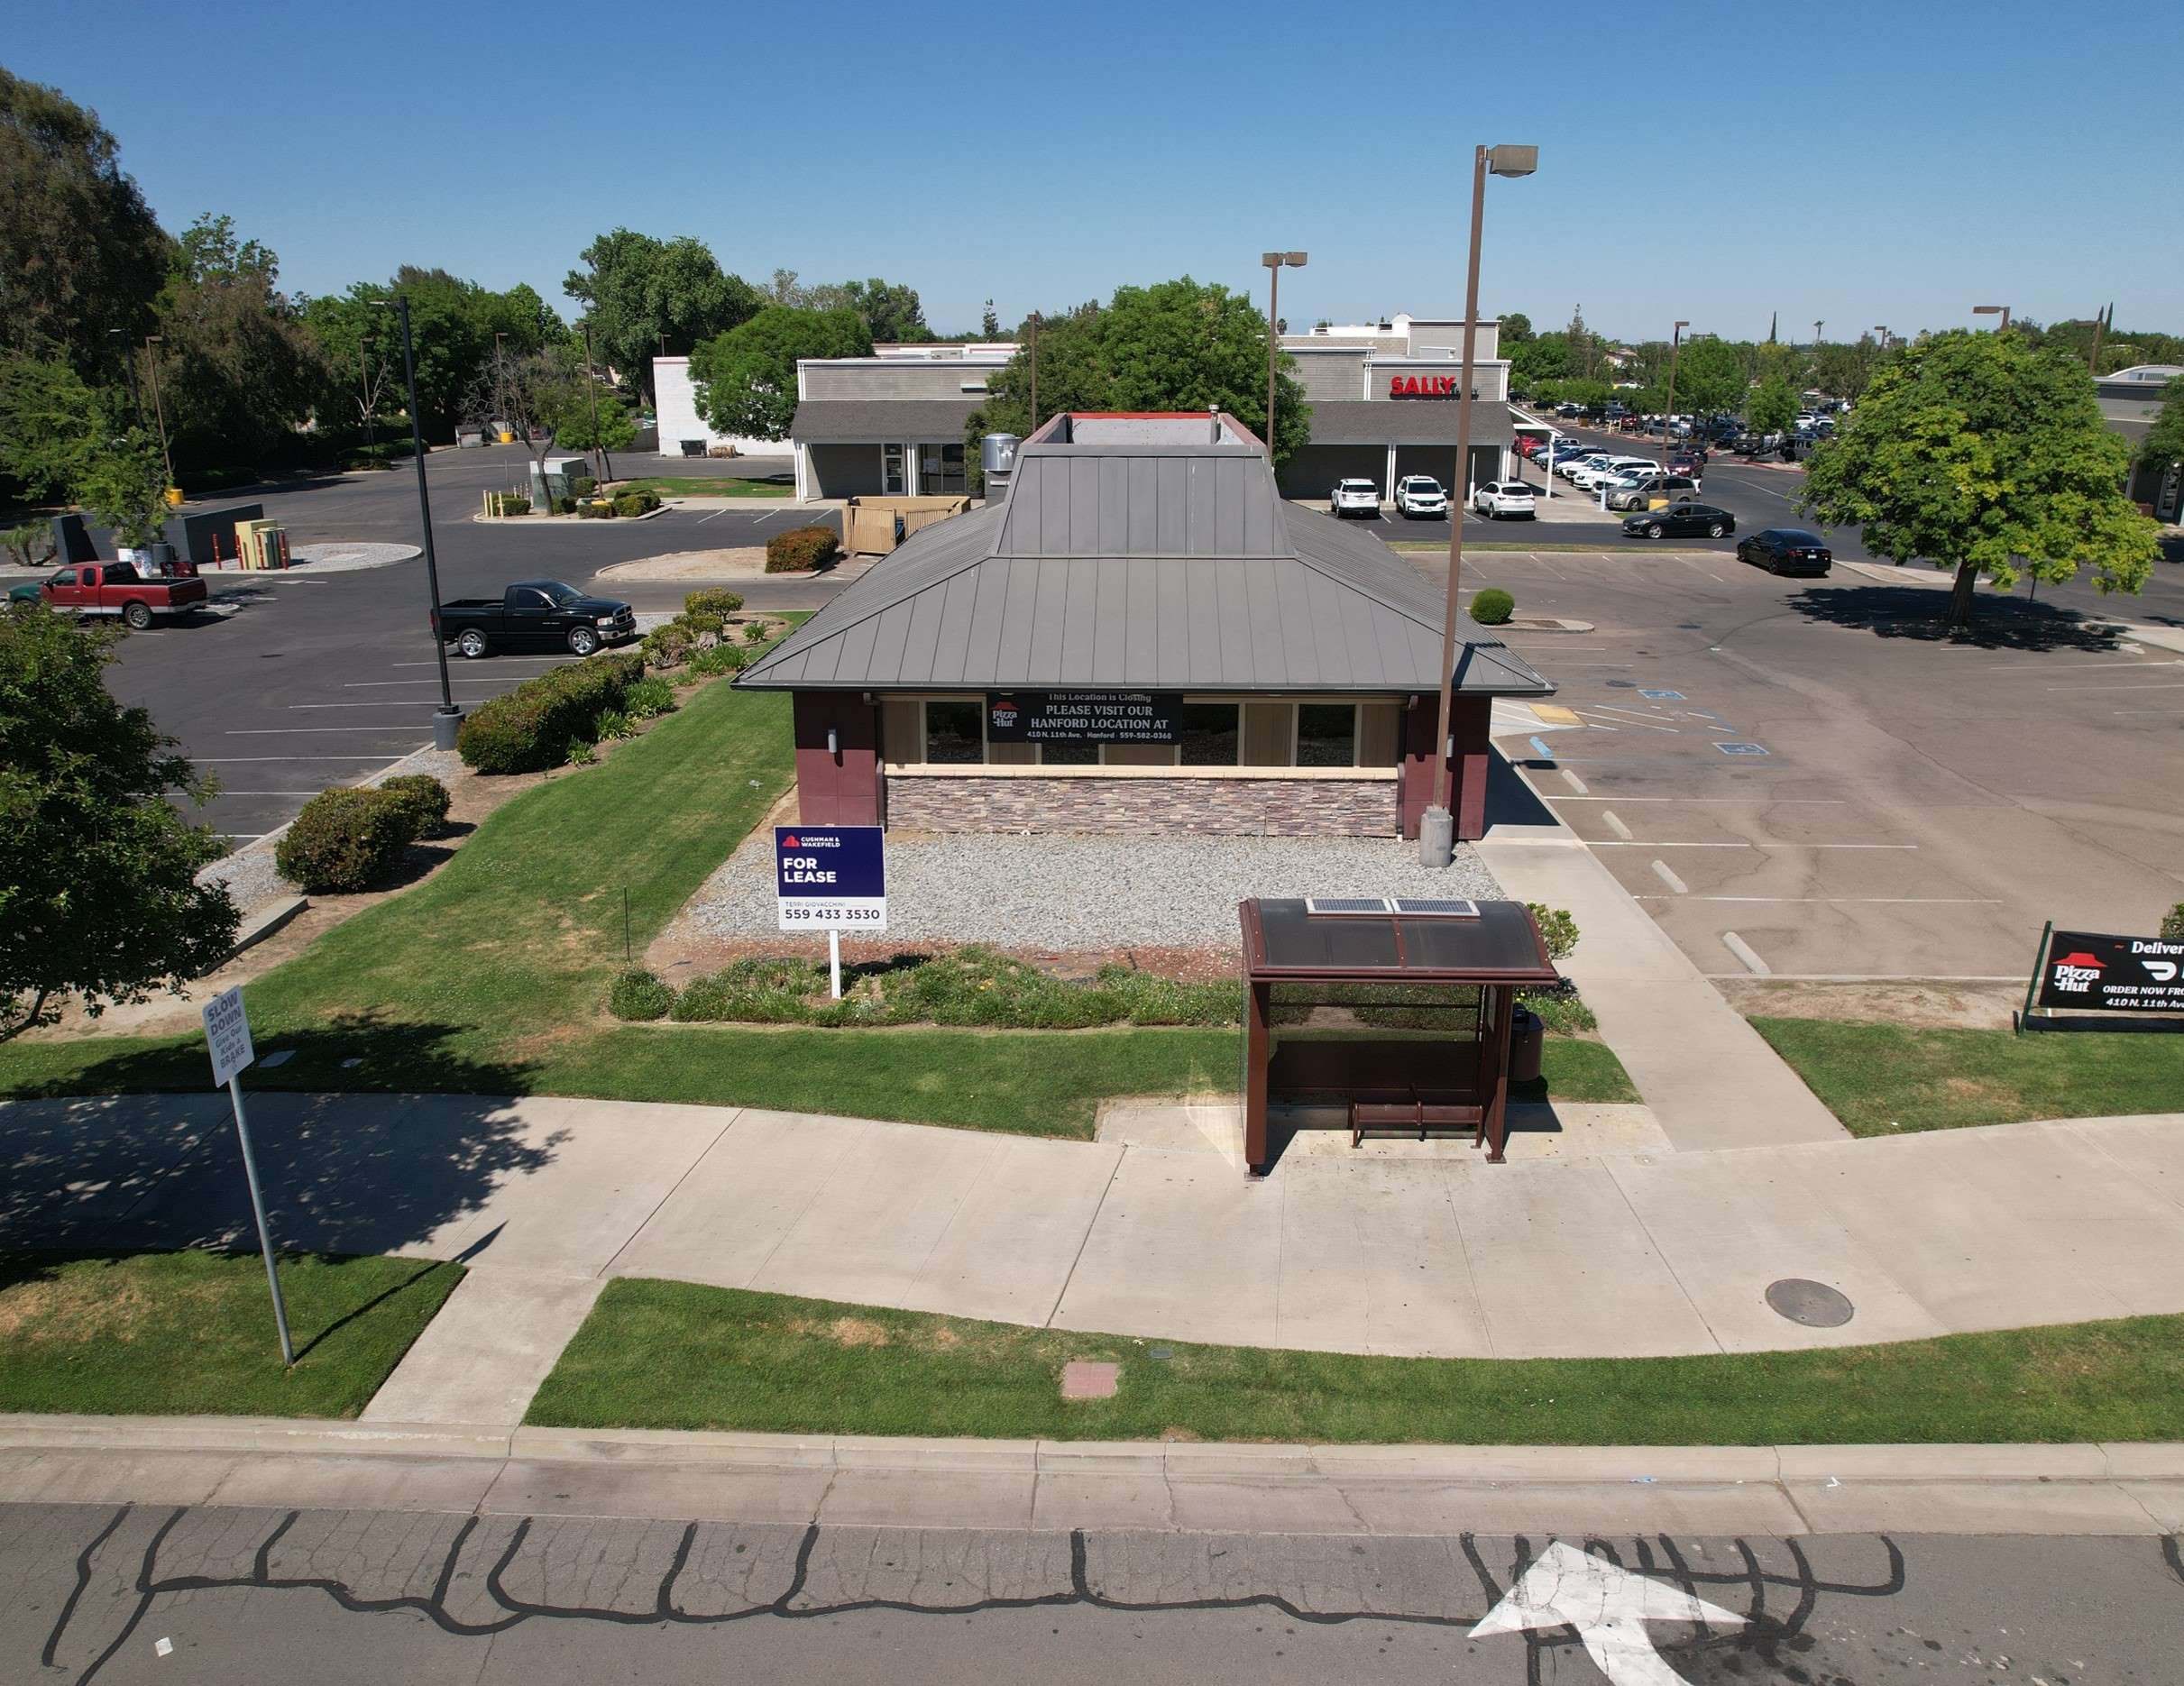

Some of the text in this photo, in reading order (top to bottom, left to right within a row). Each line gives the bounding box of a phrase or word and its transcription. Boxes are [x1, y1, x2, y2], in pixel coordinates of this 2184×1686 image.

[1391, 375, 1455, 394] SALLY
[993, 710, 1017, 719] Pizza
[1046, 705, 1153, 716] PLEASE VISIT OUR
[993, 719, 1014, 727] Hut
[1031, 719, 1169, 728] HANFORD LOCATION AT
[784, 857, 817, 869] FOR
[785, 871, 837, 883] LEASE
[785, 909, 880, 920] 559 433 3530
[2055, 965, 2100, 980] Pizza
[2054, 977, 2090, 992] Hut
[2103, 985, 2138, 994] ORDER
[2140, 986, 2166, 995] NOW
[207, 992, 238, 1022] SLOW
[2106, 997, 2128, 1006] 410
[2129, 998, 2140, 1007] N.
[2142, 999, 2167, 1008] 11th
[210, 1006, 242, 1036] DOWN
